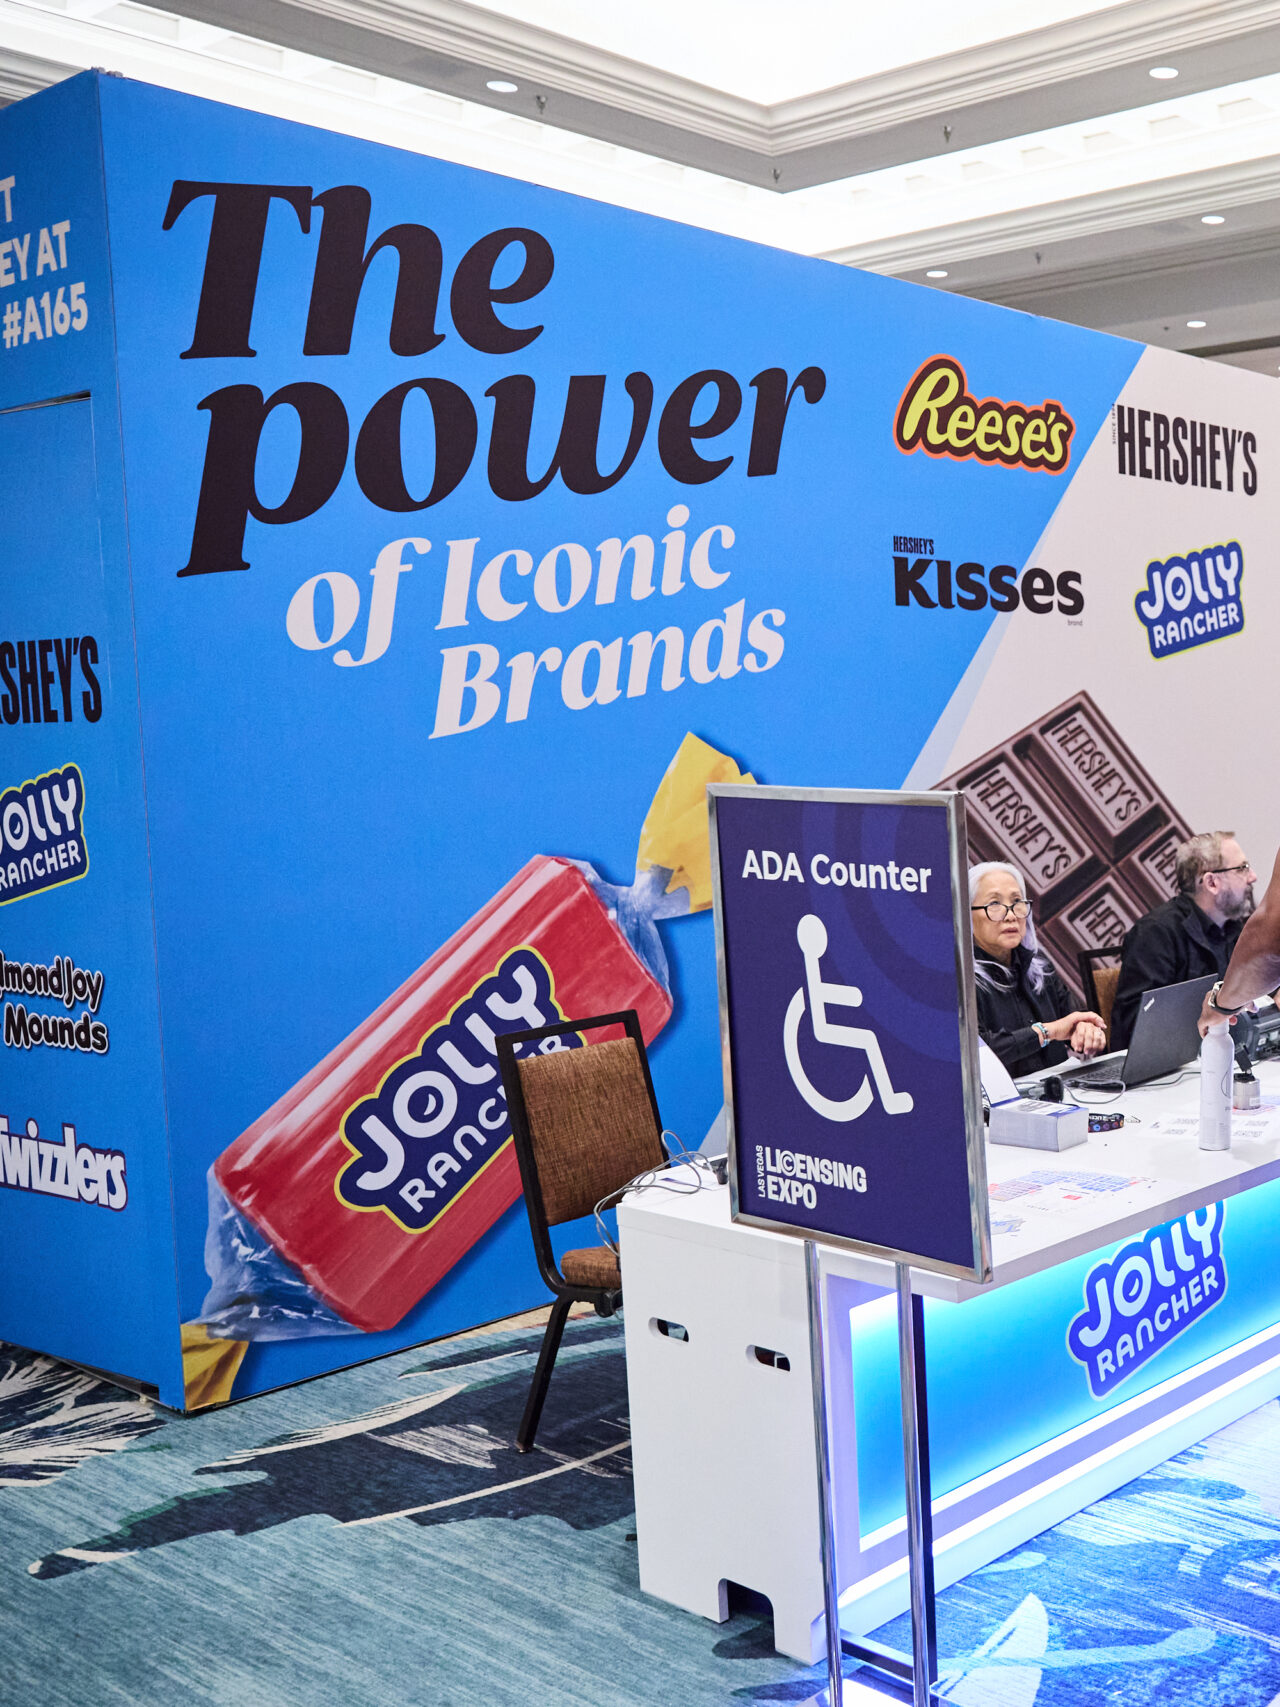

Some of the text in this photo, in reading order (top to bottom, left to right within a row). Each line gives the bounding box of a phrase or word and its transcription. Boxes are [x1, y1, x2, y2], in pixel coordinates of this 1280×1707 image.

[36, 219, 71, 277] AT
[161, 179, 555, 360] The
[2, 281, 89, 349] #A165
[176, 366, 826, 579] power
[1116, 404, 1258, 496] HERSHEY'S
[285, 503, 736, 669] of Iconic
[893, 535, 935, 555] HERSHEY'S
[1140, 550, 1239, 620] JOLLY
[429, 598, 787, 740] Brands
[1153, 602, 1240, 649] RANCHER
[0, 635, 102, 725] SHEY'S
[1050, 716, 1141, 822] HERSHEY'S
[0, 777, 77, 855] OLLY
[970, 768, 1072, 880] HERSHEY'S
[742, 849, 932, 893] ADA Counter
[4, 1003, 108, 1052] Mounds
[355, 964, 547, 1191] JOLLY
[398, 1035, 571, 1213] RANCR
[755, 1145, 766, 1198] LAS VEGAS
[767, 1174, 817, 1210] EXPO
[1078, 1202, 1217, 1348] JOLLY
[1096, 1265, 1219, 1382] RANCHER
